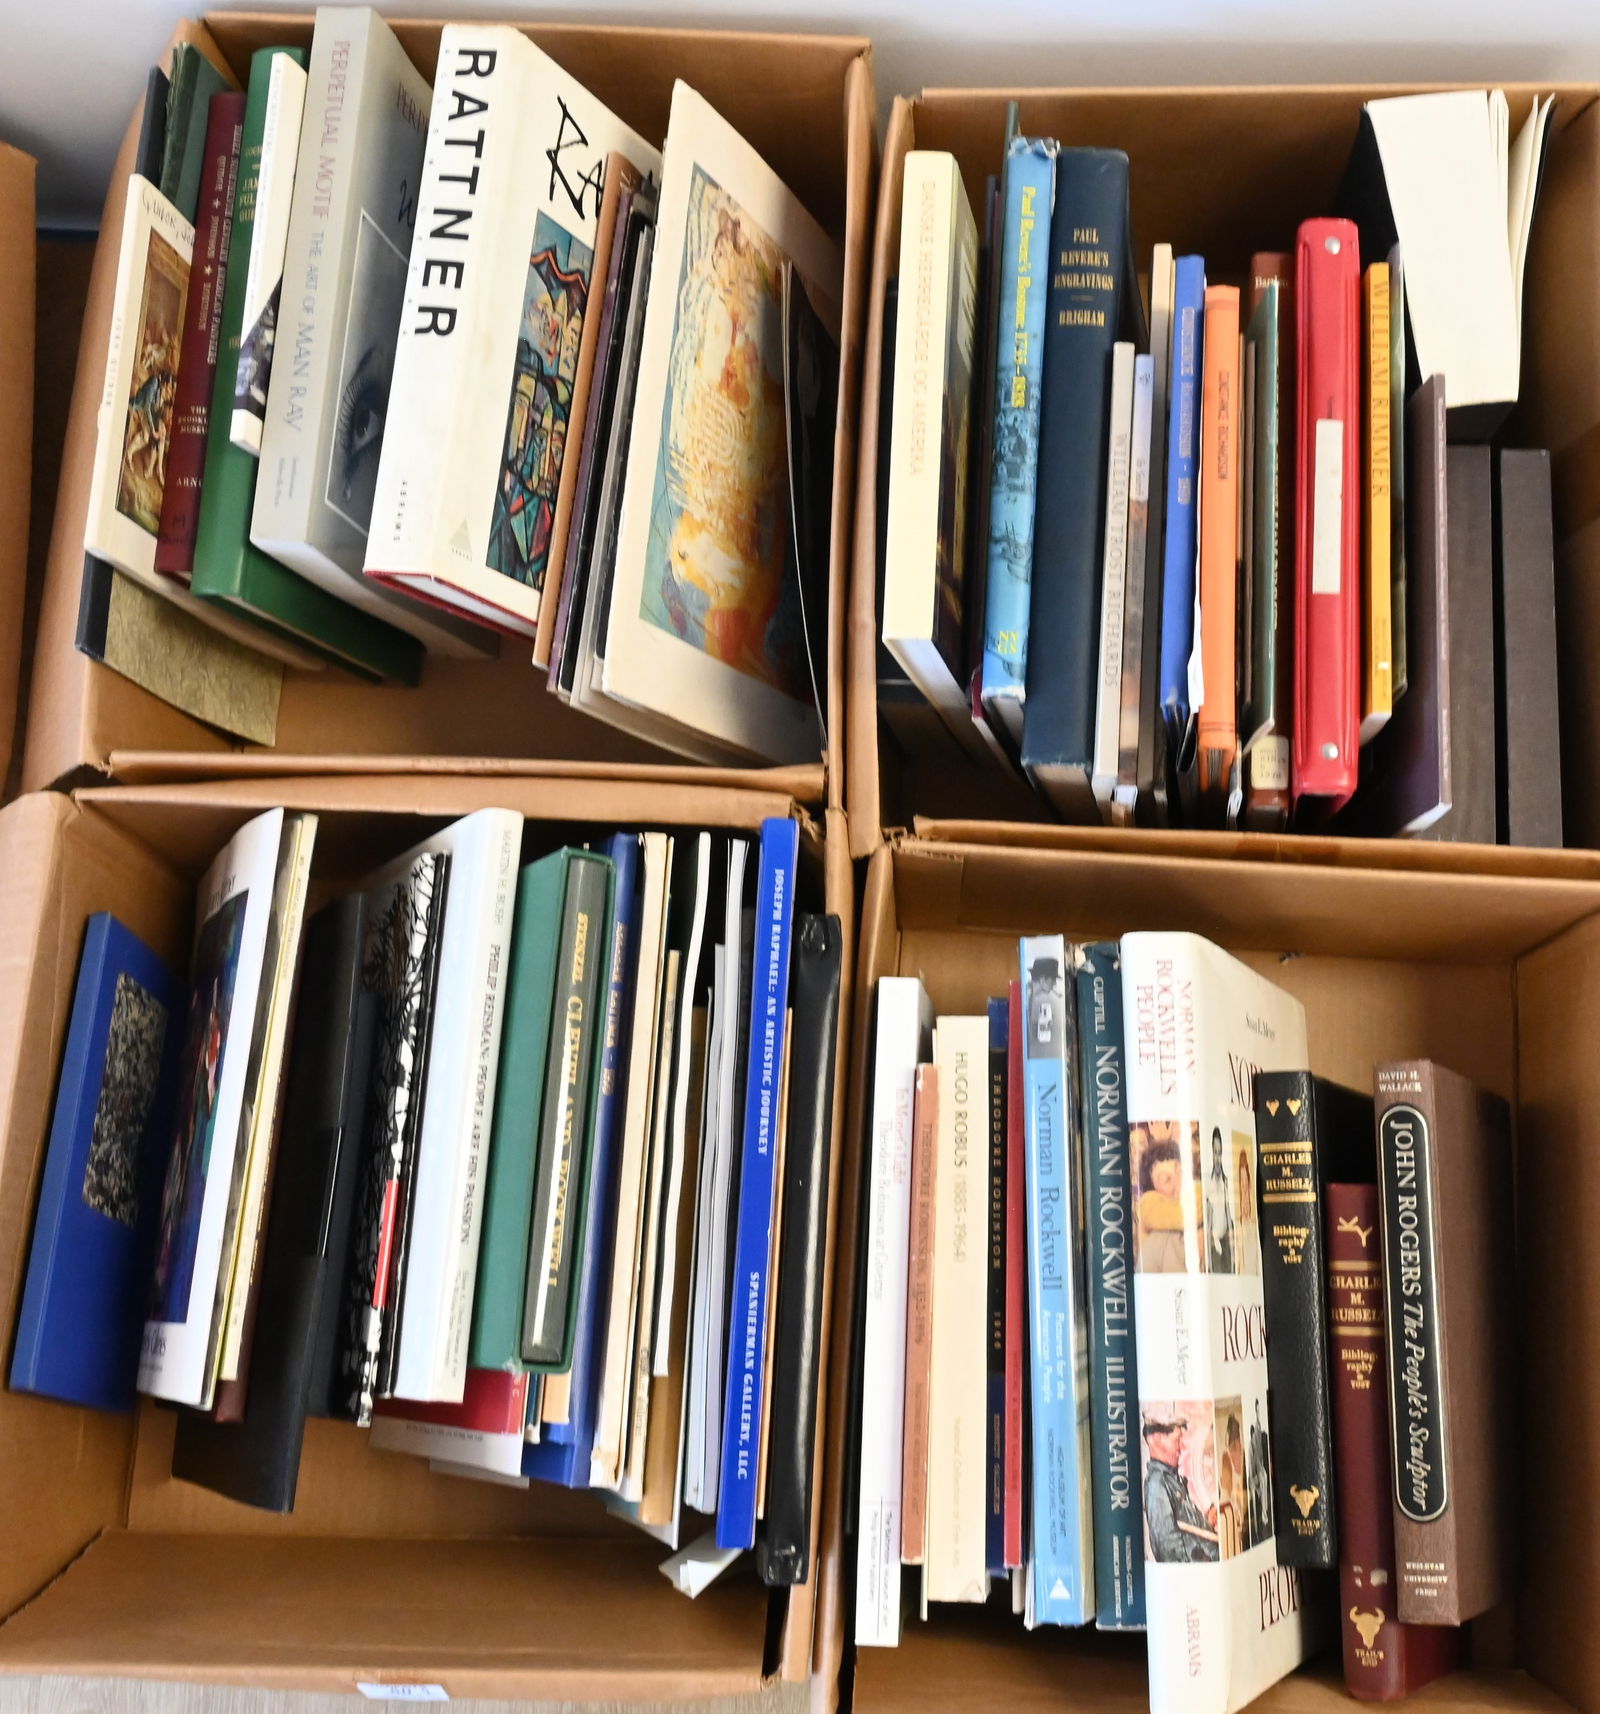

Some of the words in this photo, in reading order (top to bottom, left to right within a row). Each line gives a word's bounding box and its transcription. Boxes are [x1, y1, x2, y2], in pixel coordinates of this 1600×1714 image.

[321, 41, 351, 147] PERPETUAL
[414, 49, 498, 339] RATTNER
[1021, 186, 1037, 216] Paul
[308, 231, 325, 256] THE
[1018, 218, 1034, 274] Revere's
[1061, 250, 1109, 268] REVERE'S
[1073, 227, 1099, 244] PAUL
[305, 264, 321, 289] ART
[1054, 272, 1114, 291] ENGRAVINGS
[302, 295, 317, 316] OF
[1059, 309, 1105, 327] BRIGHAM
[293, 322, 317, 378] MAN
[1371, 280, 1389, 388] WILLIAM
[283, 385, 308, 433] RAY
[1110, 434, 1128, 516] WILLIAM
[1372, 397, 1391, 498] RIMMER
[1107, 526, 1124, 585] TROST
[1104, 591, 1122, 688] RICHARDS
[772, 869, 786, 921] JOSEPH
[486, 944, 502, 991] PHILIP
[571, 912, 589, 985] STENZEL
[768, 923, 782, 993] RAPHAEL:
[480, 993, 497, 1060] REISMAN:
[766, 996, 776, 1016] AN
[1094, 977, 1106, 1034] GUPTILL
[1135, 984, 1157, 1068] PEOPLE
[1155, 960, 1179, 1098] ROCKWELL'S
[1175, 979, 1196, 1076] NORMAN
[762, 1019, 777, 1087] ARTISTIC
[954, 1052, 969, 1104] HUGO
[1378, 1071, 1406, 1082] DAVID
[1409, 1070, 1420, 1081] H.
[474, 1064, 490, 1118] PEOPLE
[1095, 1045, 1121, 1176] NORMAN
[1378, 1082, 1423, 1093] WALLACK
[471, 1122, 483, 1150] ARE
[757, 1089, 774, 1157] JOURNEY
[953, 1111, 968, 1168] ROBUS
[992, 1074, 1002, 1168] THEODORE
[1037, 1083, 1058, 1177] Norman
[467, 1154, 480, 1179] HIS
[919, 1122, 935, 1197] THEODORE
[1263, 1152, 1312, 1166] CHARLES
[1281, 1166, 1294, 1178] M.
[1391, 1120, 1412, 1187] JOHN
[1265, 1177, 1314, 1191] RUSSELL
[459, 1183, 477, 1243] PASSION
[992, 1177, 1002, 1270] ROBINSON
[1039, 1185, 1062, 1291] Rockwell
[1099, 1186, 1129, 1347] ROCKWELL
[1398, 1197, 1422, 1295] ROGERS
[743, 1271, 761, 1371] SPANIERMAN
[1174, 1288, 1189, 1327] Susan
[1350, 1292, 1365, 1306] M.
[1403, 1301, 1425, 1337] The
[1041, 1310, 1053, 1361] American
[1055, 1312, 1066, 1353] Pictures
[1041, 1366, 1054, 1405] People
[1056, 1359, 1067, 1378] for
[1056, 1381, 1067, 1401] the
[1175, 1345, 1192, 1386] Meyer
[1405, 1341, 1429, 1418] People's
[738, 1373, 754, 1447] GALLERY,
[1106, 1356, 1130, 1511] ILLUSTRATOR
[737, 1450, 748, 1480] LLC
[1057, 1469, 1066, 1506] MUSEUM
[1407, 1422, 1431, 1511] Sculptor
[1403, 1574, 1448, 1585] UNIVERSITY
[1405, 1562, 1446, 1571] WESLEYAN
[1414, 1588, 1438, 1598] PRESS
[1185, 1605, 1203, 1679] ABRAMS
